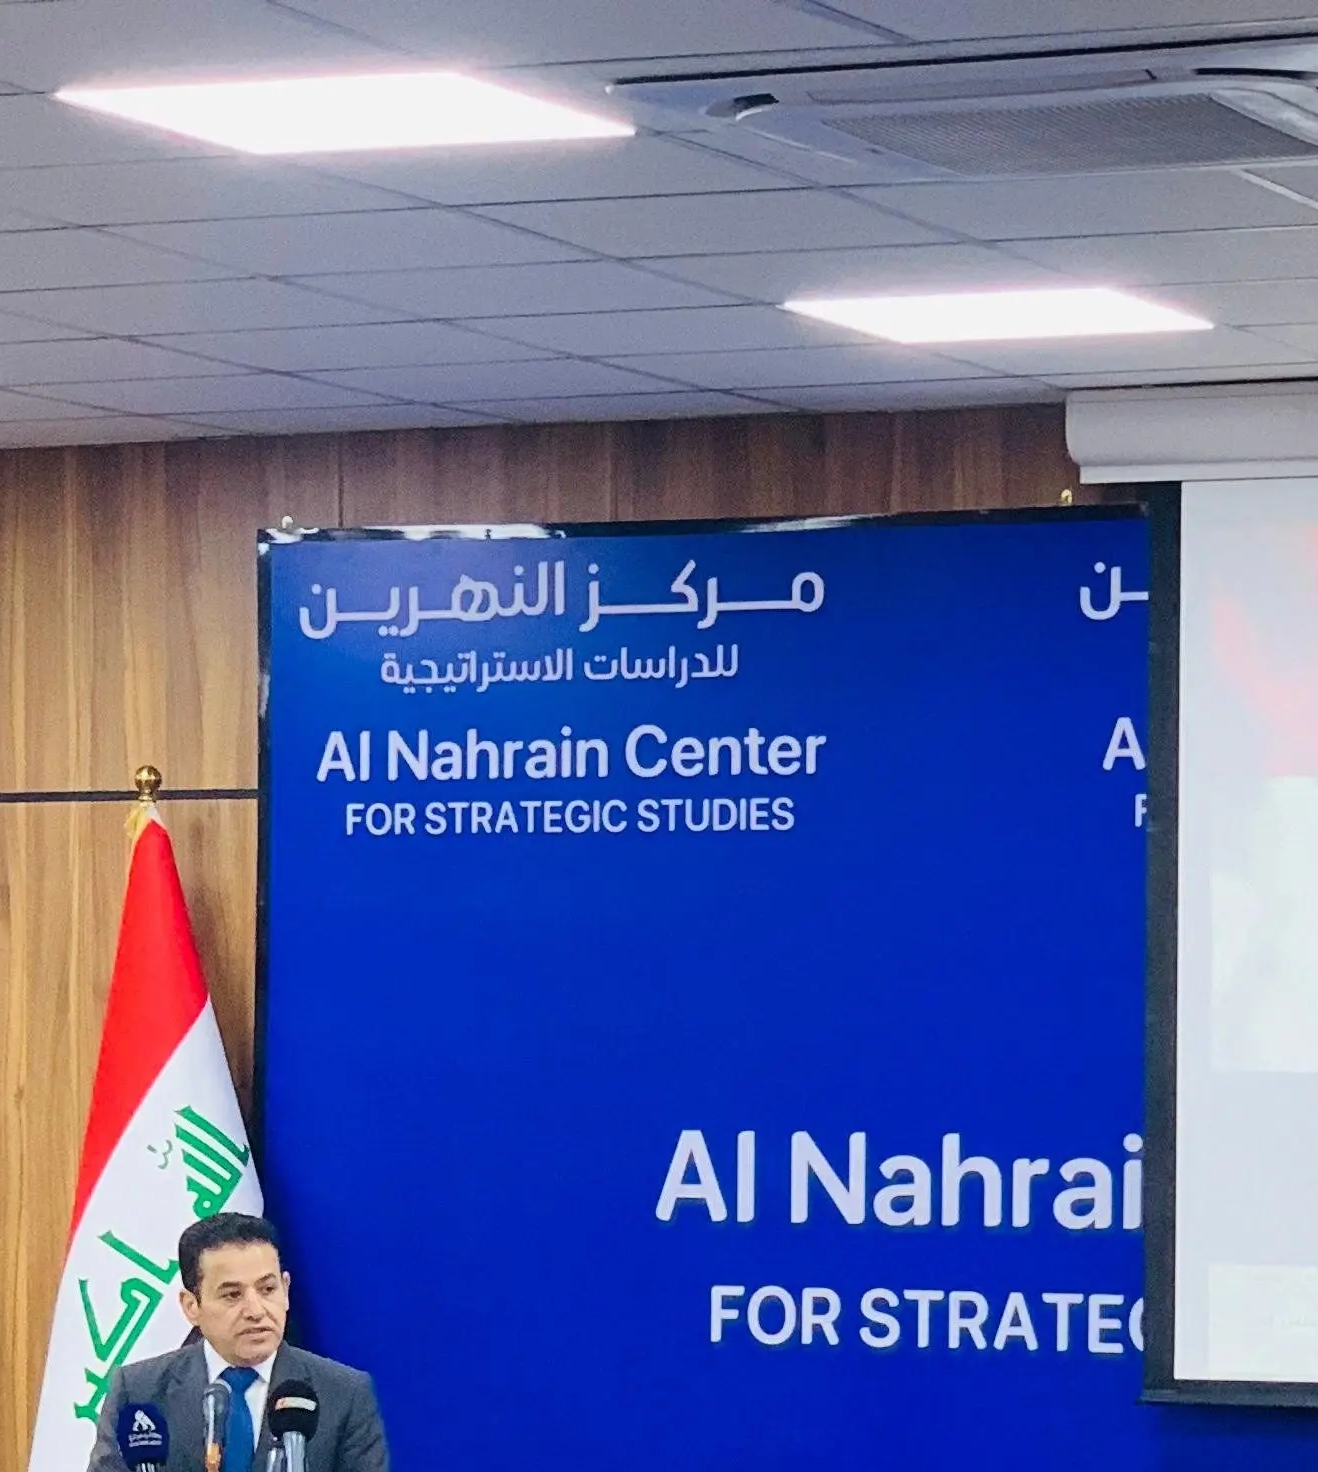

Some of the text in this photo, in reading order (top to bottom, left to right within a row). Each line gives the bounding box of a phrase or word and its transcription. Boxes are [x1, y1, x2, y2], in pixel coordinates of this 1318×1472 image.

[299, 560, 825, 639] مركز النهرين
[381, 644, 738, 693] للدراسات الاستراتيجية
[316, 724, 827, 782] Al Nahrain Center
[1102, 717, 1147, 771] A
[346, 797, 795, 836] FOR STRATEGIC STUDIES
[655, 1129, 1144, 1230] Al Nahrai
[710, 1285, 1145, 1354] FOR STRATE
